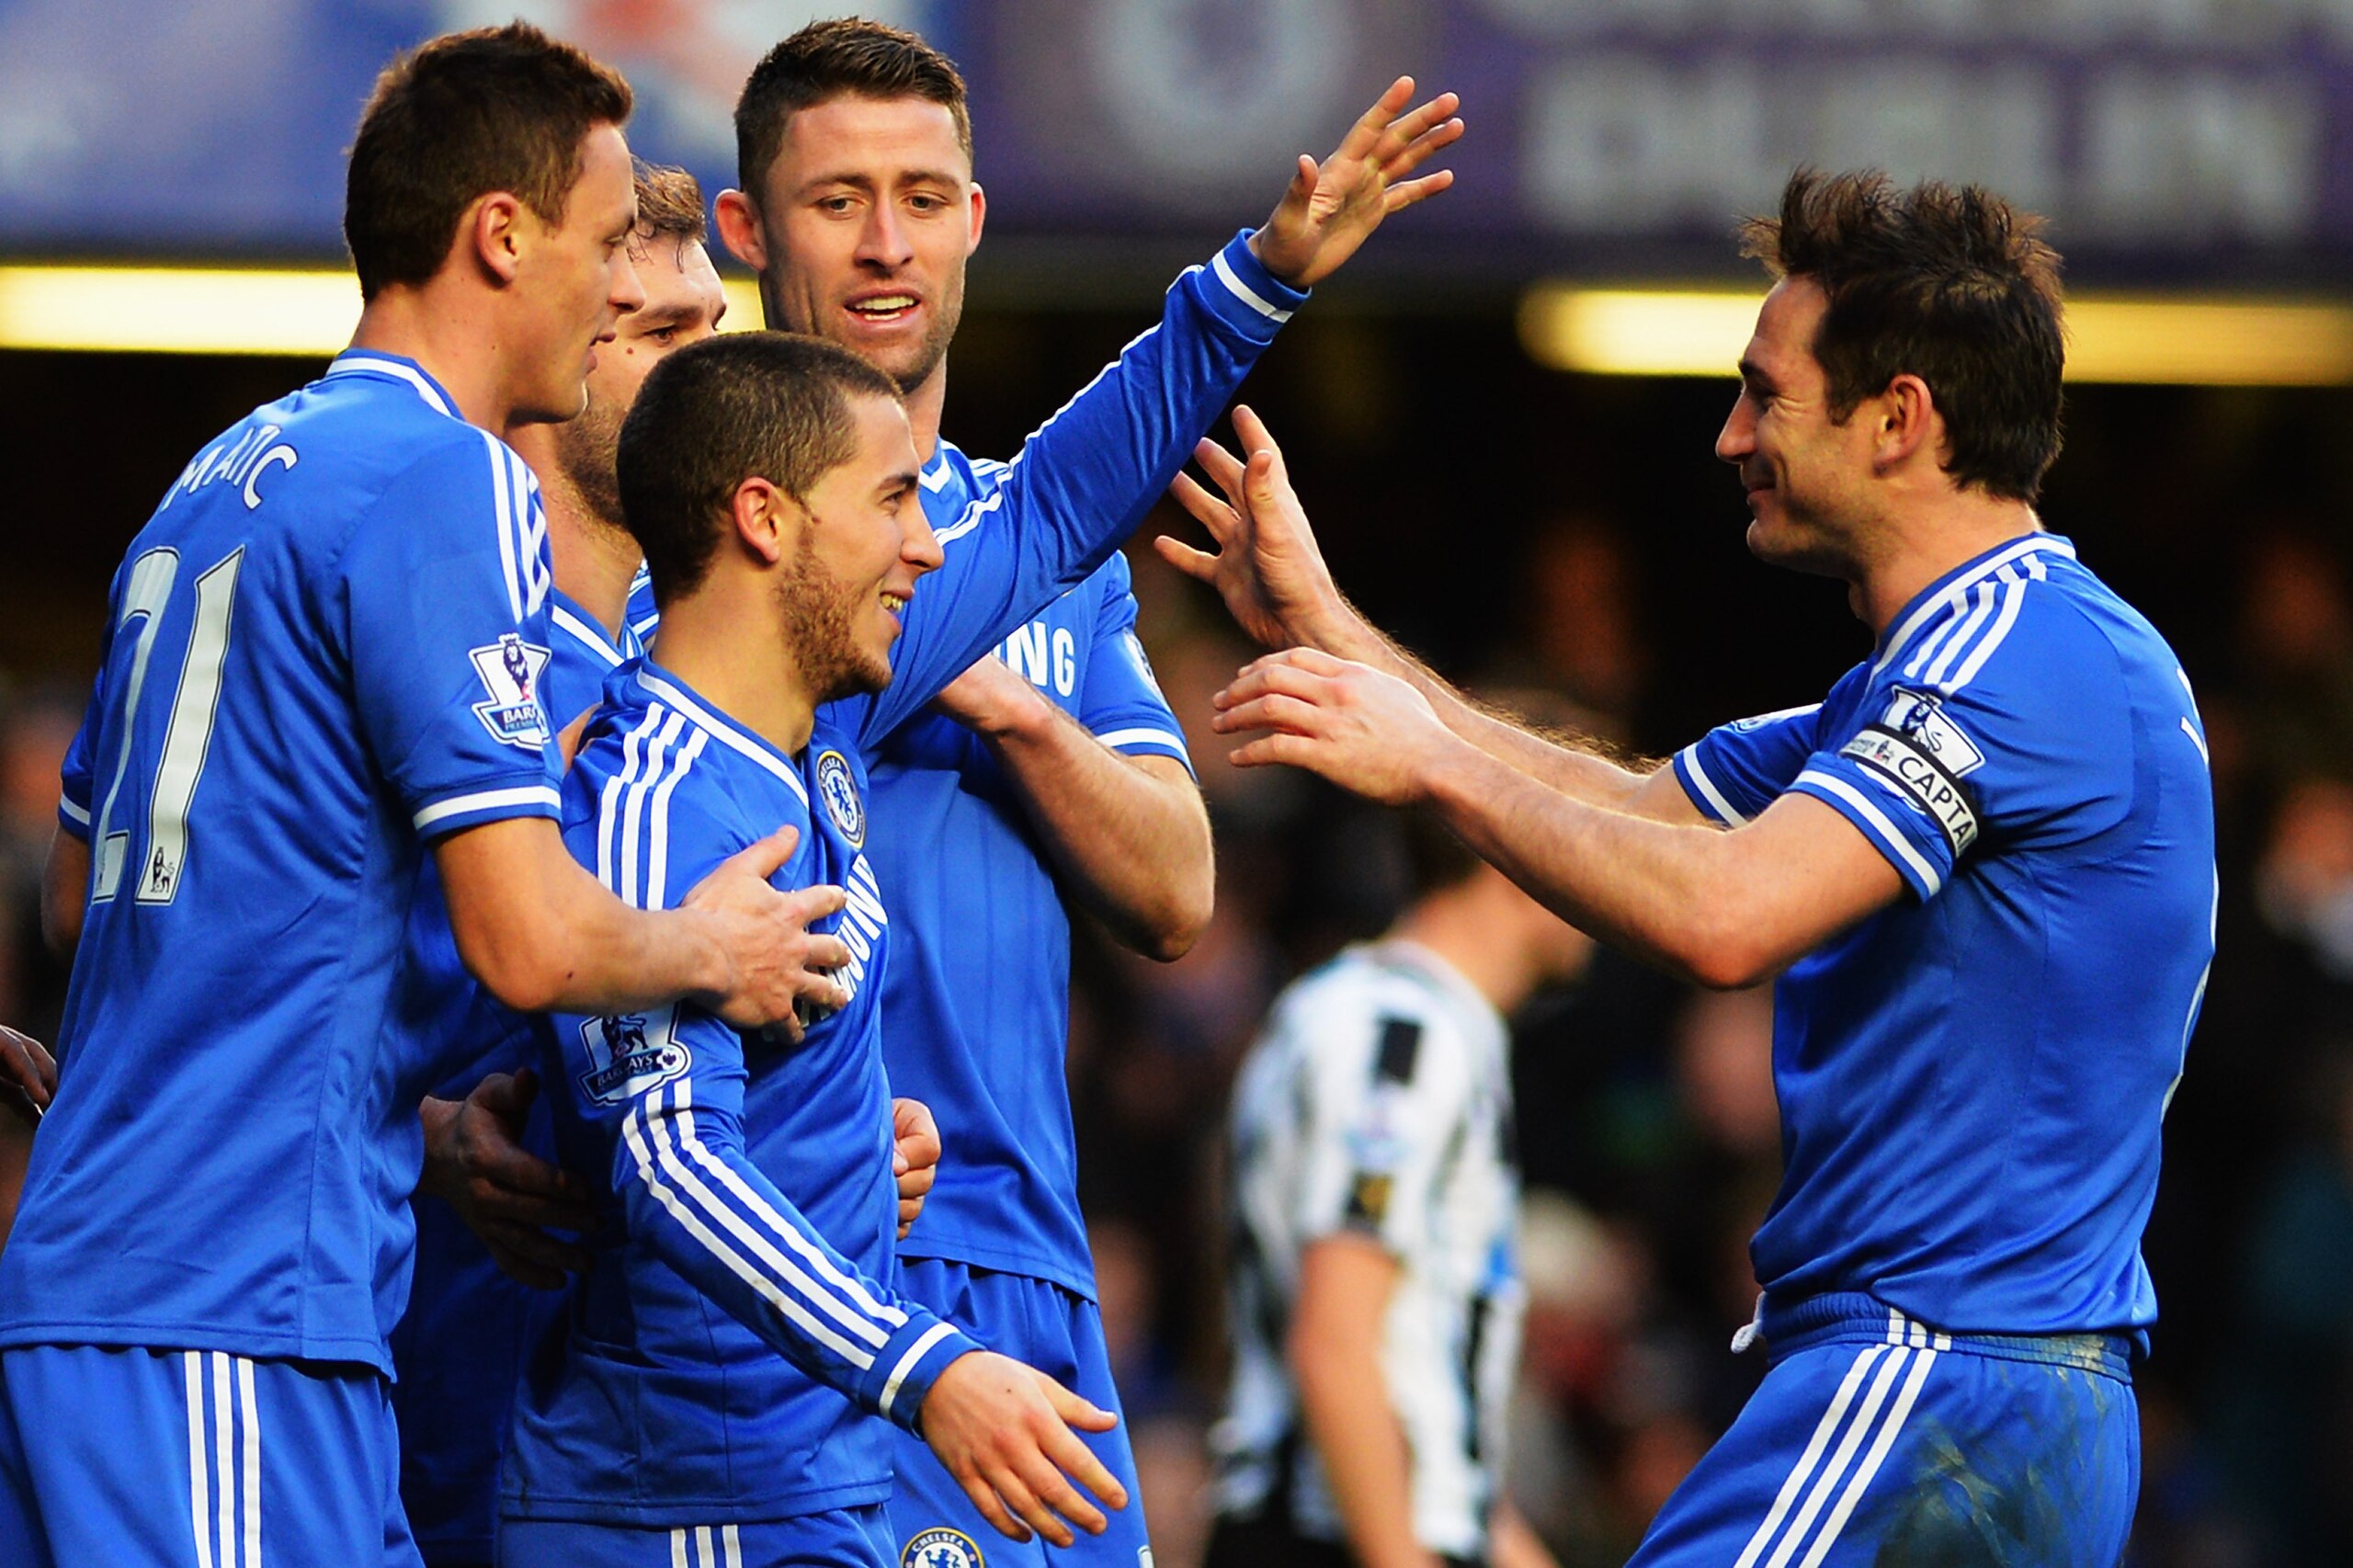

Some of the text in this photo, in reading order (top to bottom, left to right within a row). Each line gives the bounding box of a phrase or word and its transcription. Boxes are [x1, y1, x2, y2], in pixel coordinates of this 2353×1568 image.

[994, 620, 1075, 698] NG
[92, 544, 245, 906] 21
[596, 1053, 654, 1087] BARAYS
[912, 1532, 965, 1553] CHELSEA
